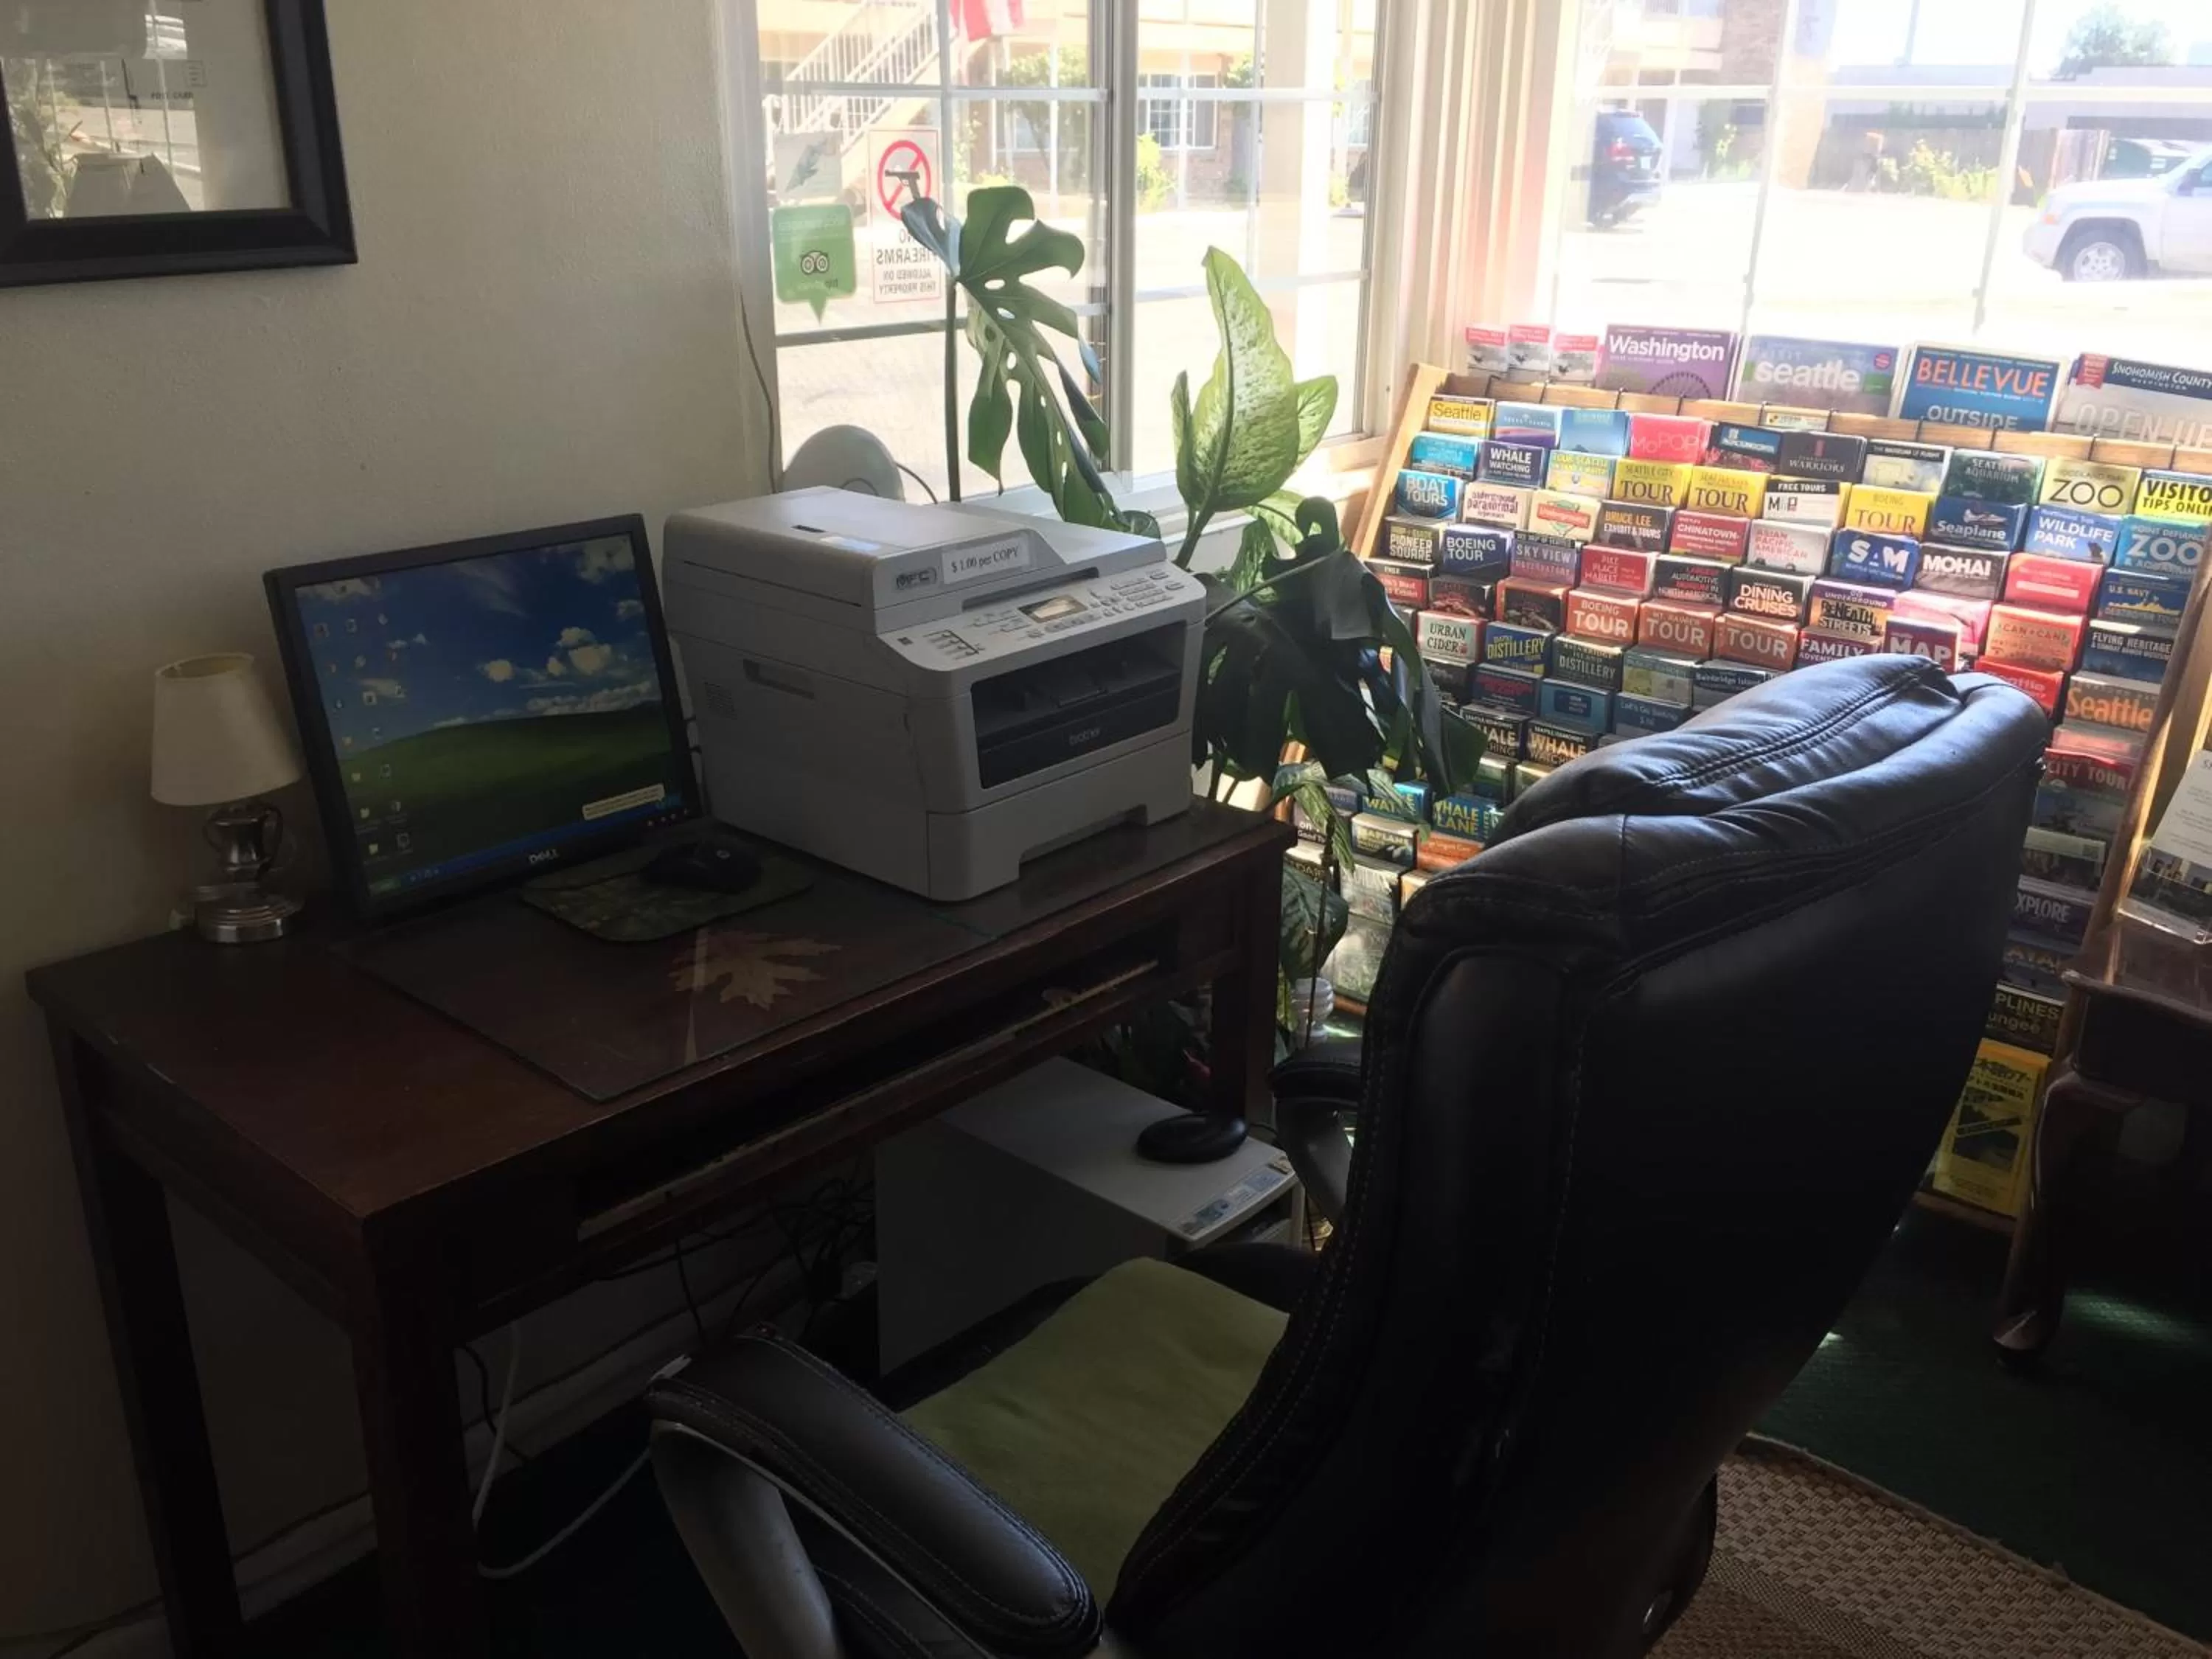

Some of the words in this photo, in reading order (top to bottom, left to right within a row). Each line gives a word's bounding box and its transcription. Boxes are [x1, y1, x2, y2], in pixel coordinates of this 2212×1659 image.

[1609, 333, 1725, 363] Washington
[1754, 358, 1860, 392] seattle
[1917, 357, 2051, 397] BELLEVUE
[1433, 402, 1482, 421] Seattle
[1927, 405, 2019, 430] OUTSIDE
[1489, 447, 1532, 465] WHALE
[1489, 459, 1531, 475] WATCHING
[1405, 476, 1449, 496] BOAT
[1621, 480, 1674, 504] TOUR
[1778, 482, 1799, 492] FREE
[1800, 484, 1827, 493] TOURS
[2049, 479, 2124, 508] ZOO
[1405, 490, 1449, 507] TOURS
[1694, 487, 1749, 513] TOUR
[2143, 496, 2171, 511] TIPS
[1604, 510, 1633, 525] BRUCE
[1635, 514, 1652, 527] LEE
[1854, 508, 1916, 533] TOUR
[2038, 516, 2115, 543] WILDLIFE
[1937, 520, 2007, 540] Seaplane
[2034, 530, 2078, 550] PARK
[1389, 545, 1432, 563] SQUARE
[1390, 533, 1433, 553] PIONEER
[1446, 536, 1497, 552] BOEING
[1517, 543, 1538, 558] SKY
[1543, 548, 1571, 565] VIEW
[2126, 533, 2204, 566] ZOO
[979, 554, 992, 568] per
[992, 545, 1020, 563] COPY
[1447, 549, 1484, 562] TOUR
[1922, 554, 1992, 576] MOHAI
[1741, 584, 1794, 604] DINING
[1580, 599, 1621, 616] BOEING
[1733, 597, 1797, 618] CRUISES
[1429, 622, 1467, 639] URBAN
[1573, 610, 1629, 638] TOUR
[1646, 619, 1705, 647] TOUR
[1818, 616, 1873, 636] STREETS
[1427, 636, 1459, 653] CIDER
[1486, 637, 1546, 660] DISTILLERY
[1727, 628, 1788, 660] TOUR
[1800, 638, 1865, 657] FAMILY
[1890, 636, 1953, 664] MAP
[2092, 631, 2124, 646] FLYING
[2127, 637, 2172, 655] HERITAGE
[1559, 654, 1616, 679] DISTILLERY
[2065, 686, 2154, 732] Seattle
[1530, 729, 1587, 757] WHALE
[2017, 891, 2071, 922] XPLORE
[1994, 993, 2060, 1020] PLINES
[1986, 1011, 2042, 1035] ungee
